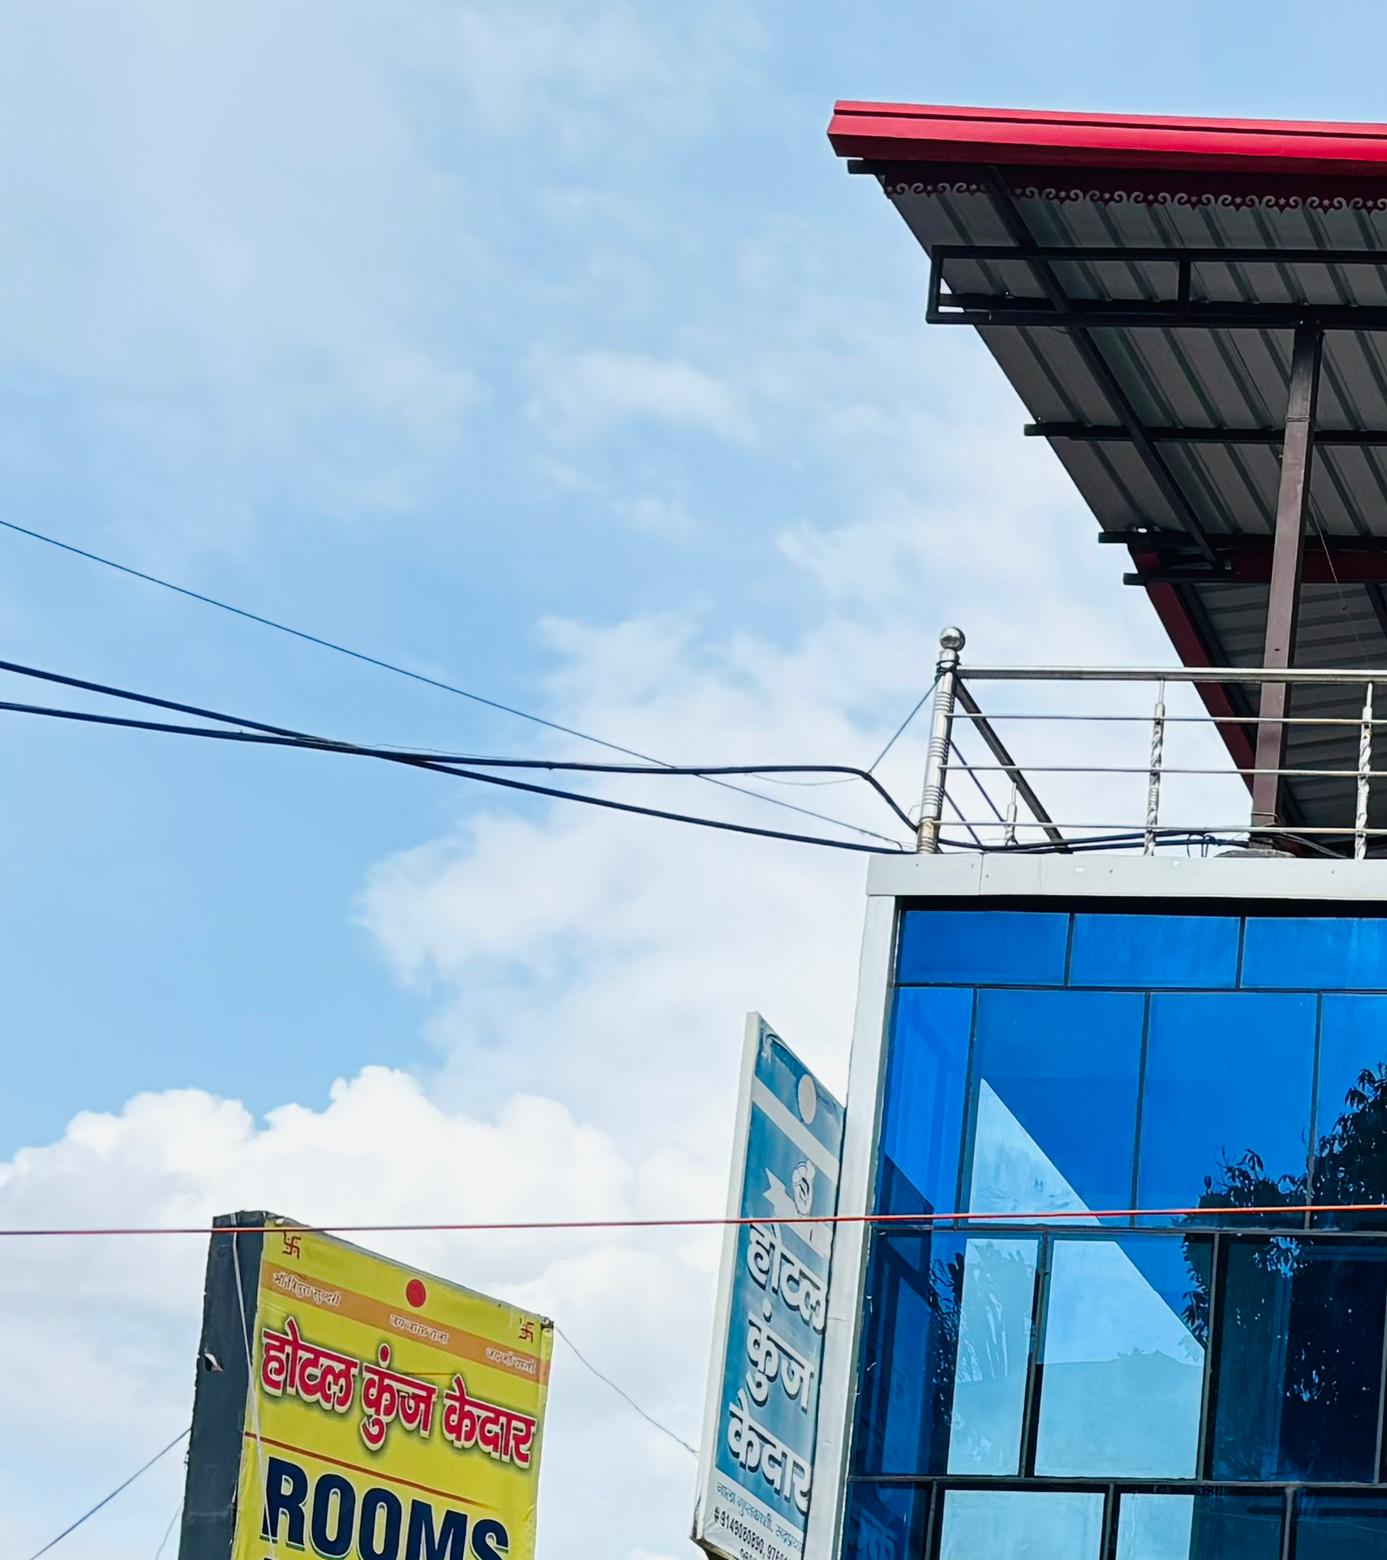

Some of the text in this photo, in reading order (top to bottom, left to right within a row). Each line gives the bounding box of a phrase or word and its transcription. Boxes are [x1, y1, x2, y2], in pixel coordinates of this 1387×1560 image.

[260, 1316, 537, 1470] होटल कुंज केदार
[746, 1298, 815, 1413] कुंज
[727, 1387, 812, 1519] केदार
